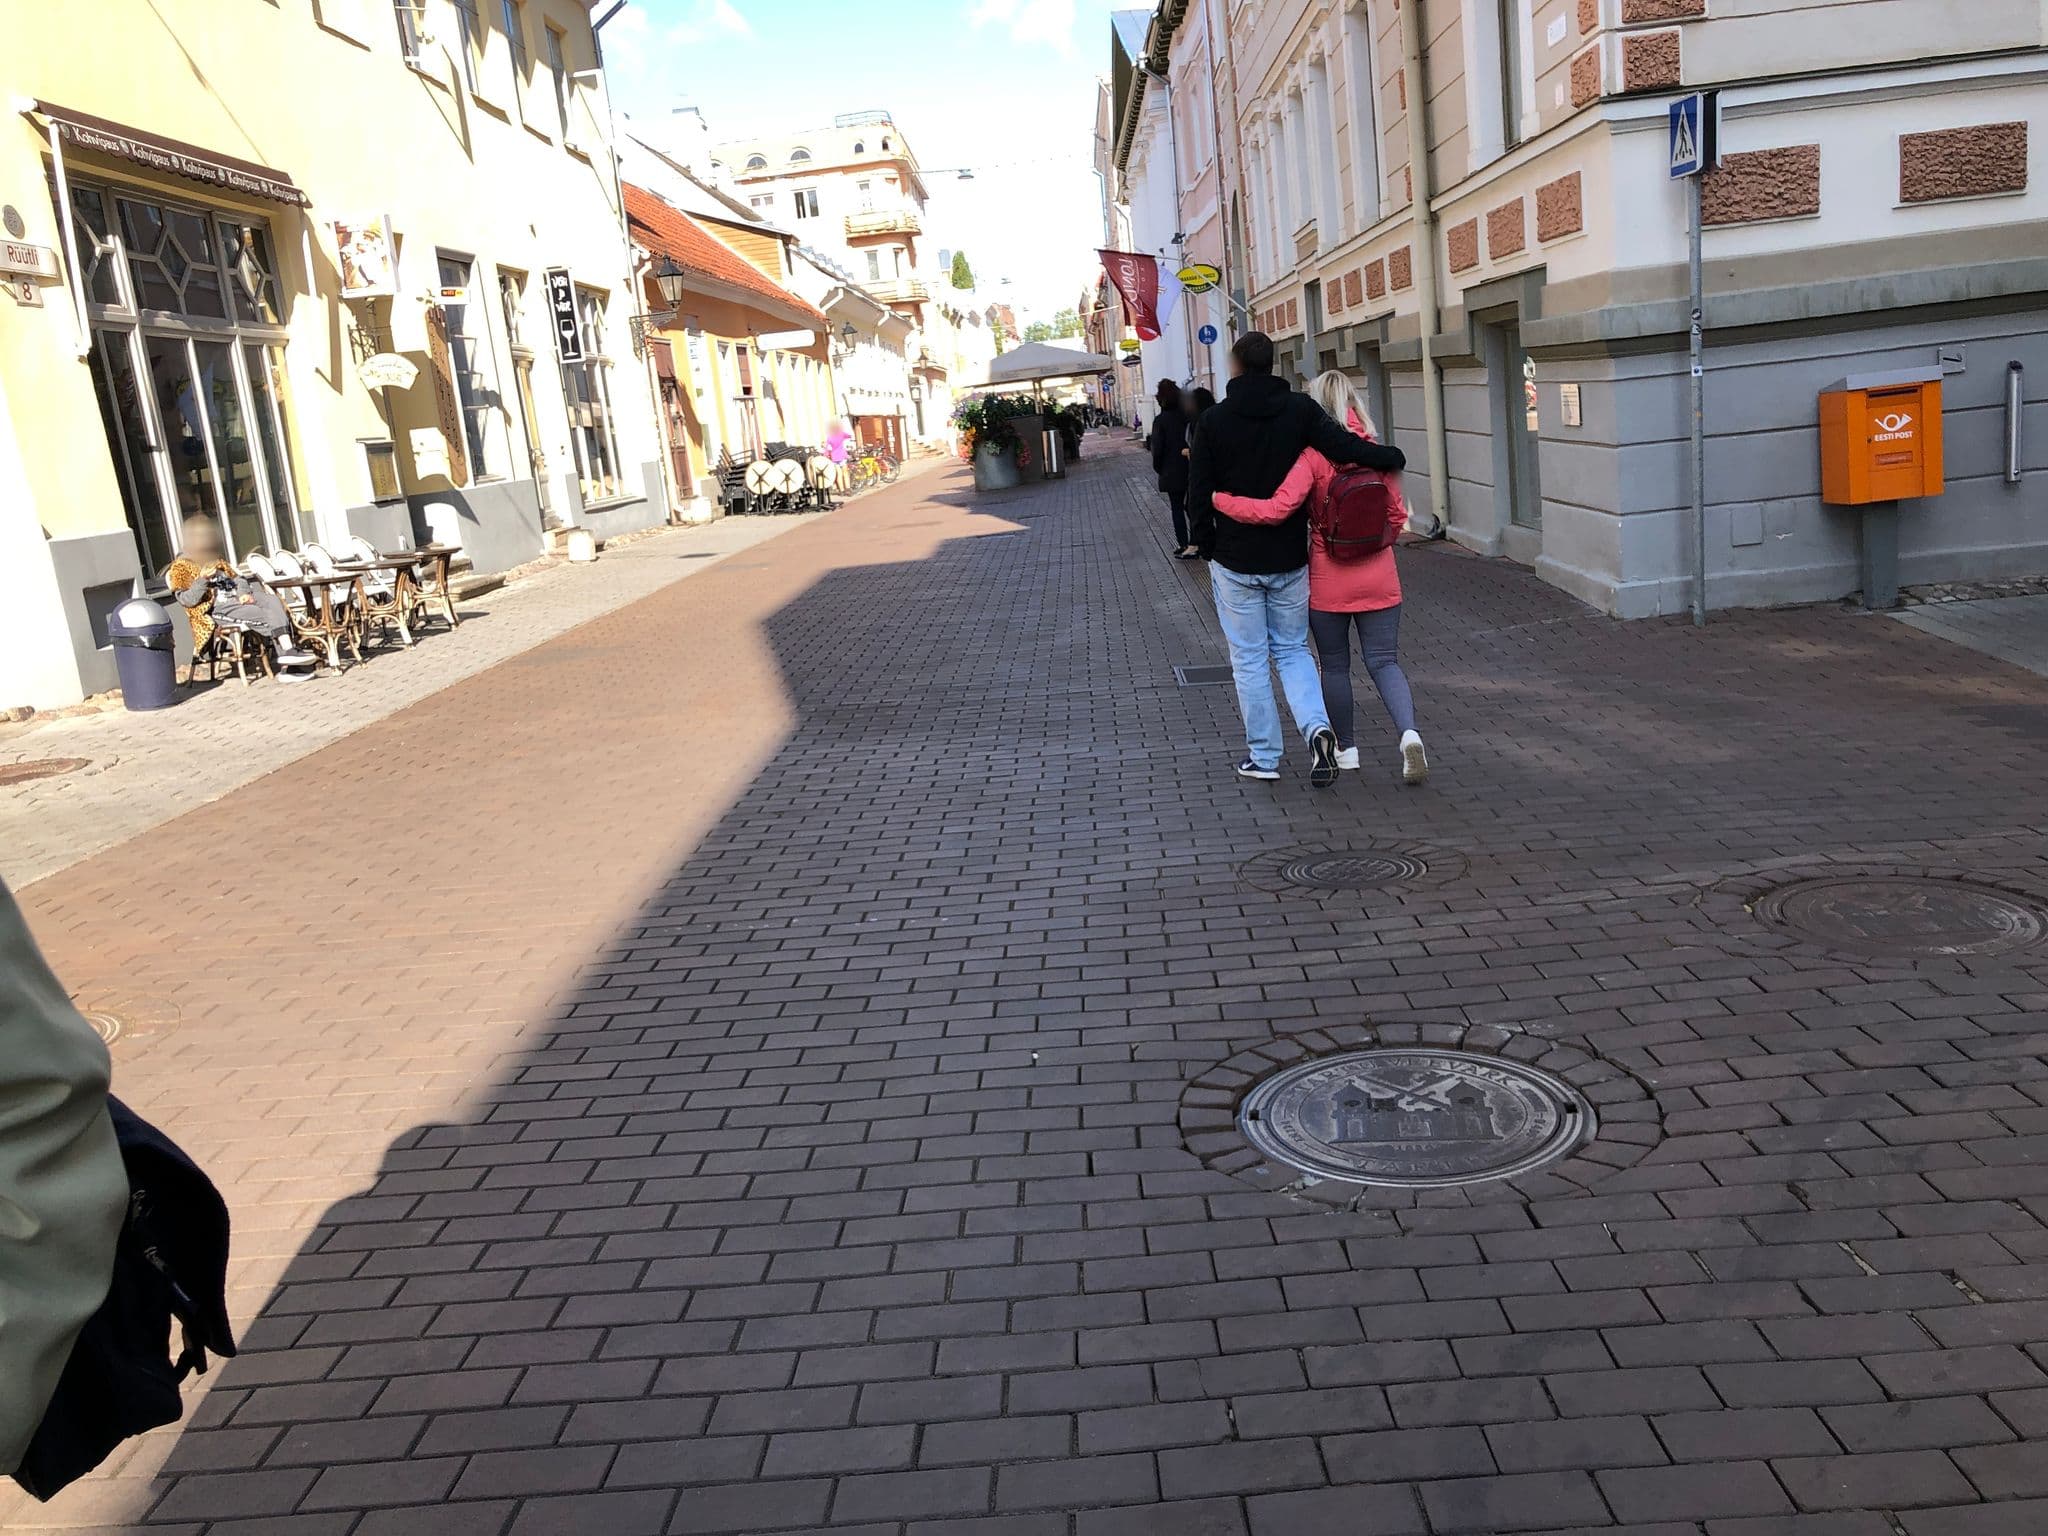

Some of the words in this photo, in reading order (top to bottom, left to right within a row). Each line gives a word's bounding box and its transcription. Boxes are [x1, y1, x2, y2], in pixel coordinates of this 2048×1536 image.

[7, 245, 39, 266] Rüütli
[22, 281, 33, 301] 8
[1874, 433, 1894, 442] EESTI
[1895, 431, 1913, 440] POST
